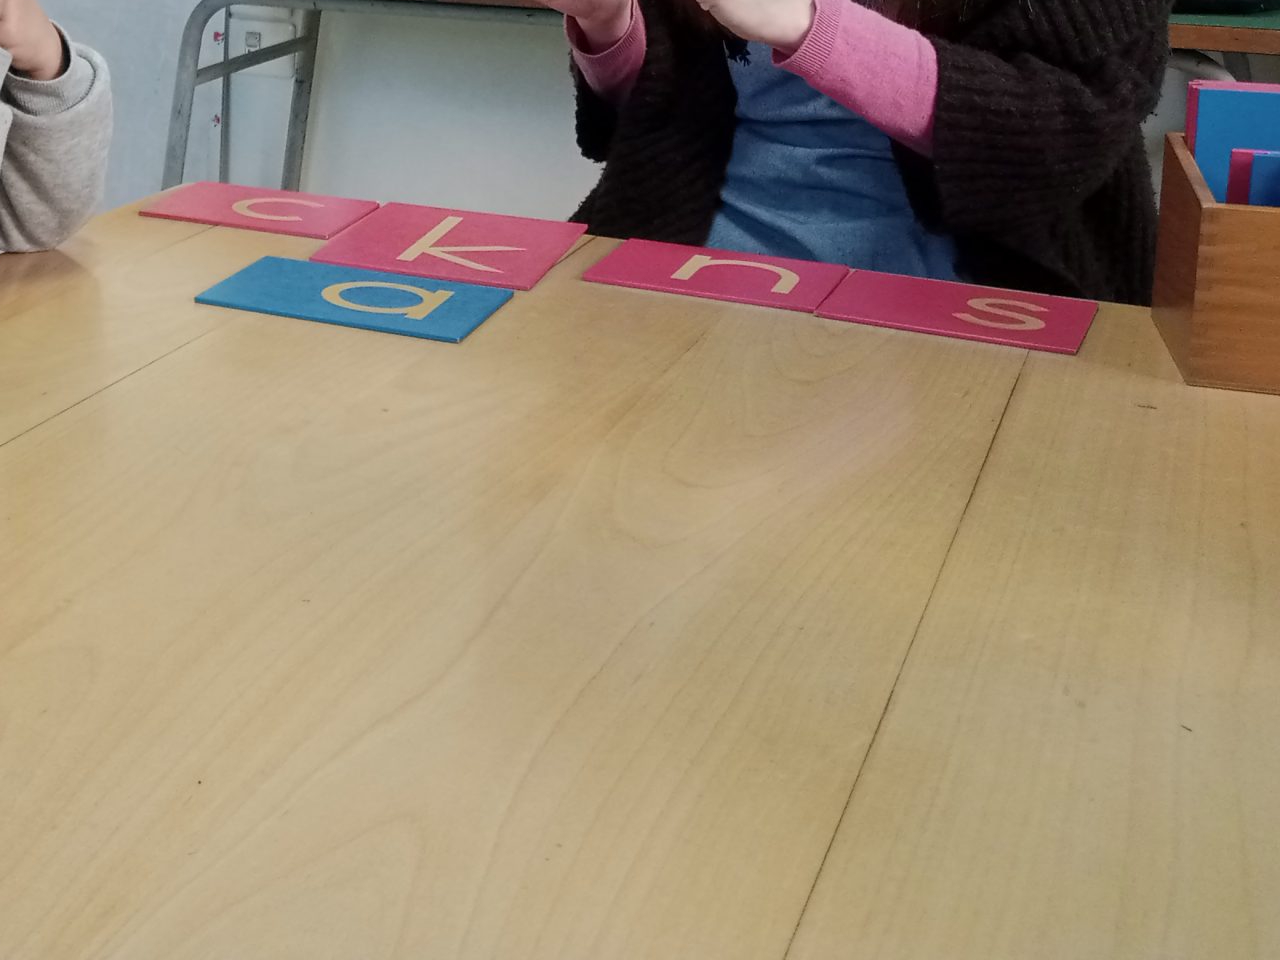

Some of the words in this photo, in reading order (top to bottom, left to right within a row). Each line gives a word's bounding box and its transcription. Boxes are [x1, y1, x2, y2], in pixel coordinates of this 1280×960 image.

[233, 197, 327, 222] c
[395, 216, 528, 274] k
[670, 254, 800, 295] n
[320, 281, 455, 320] a
[961, 294, 1050, 332] s
